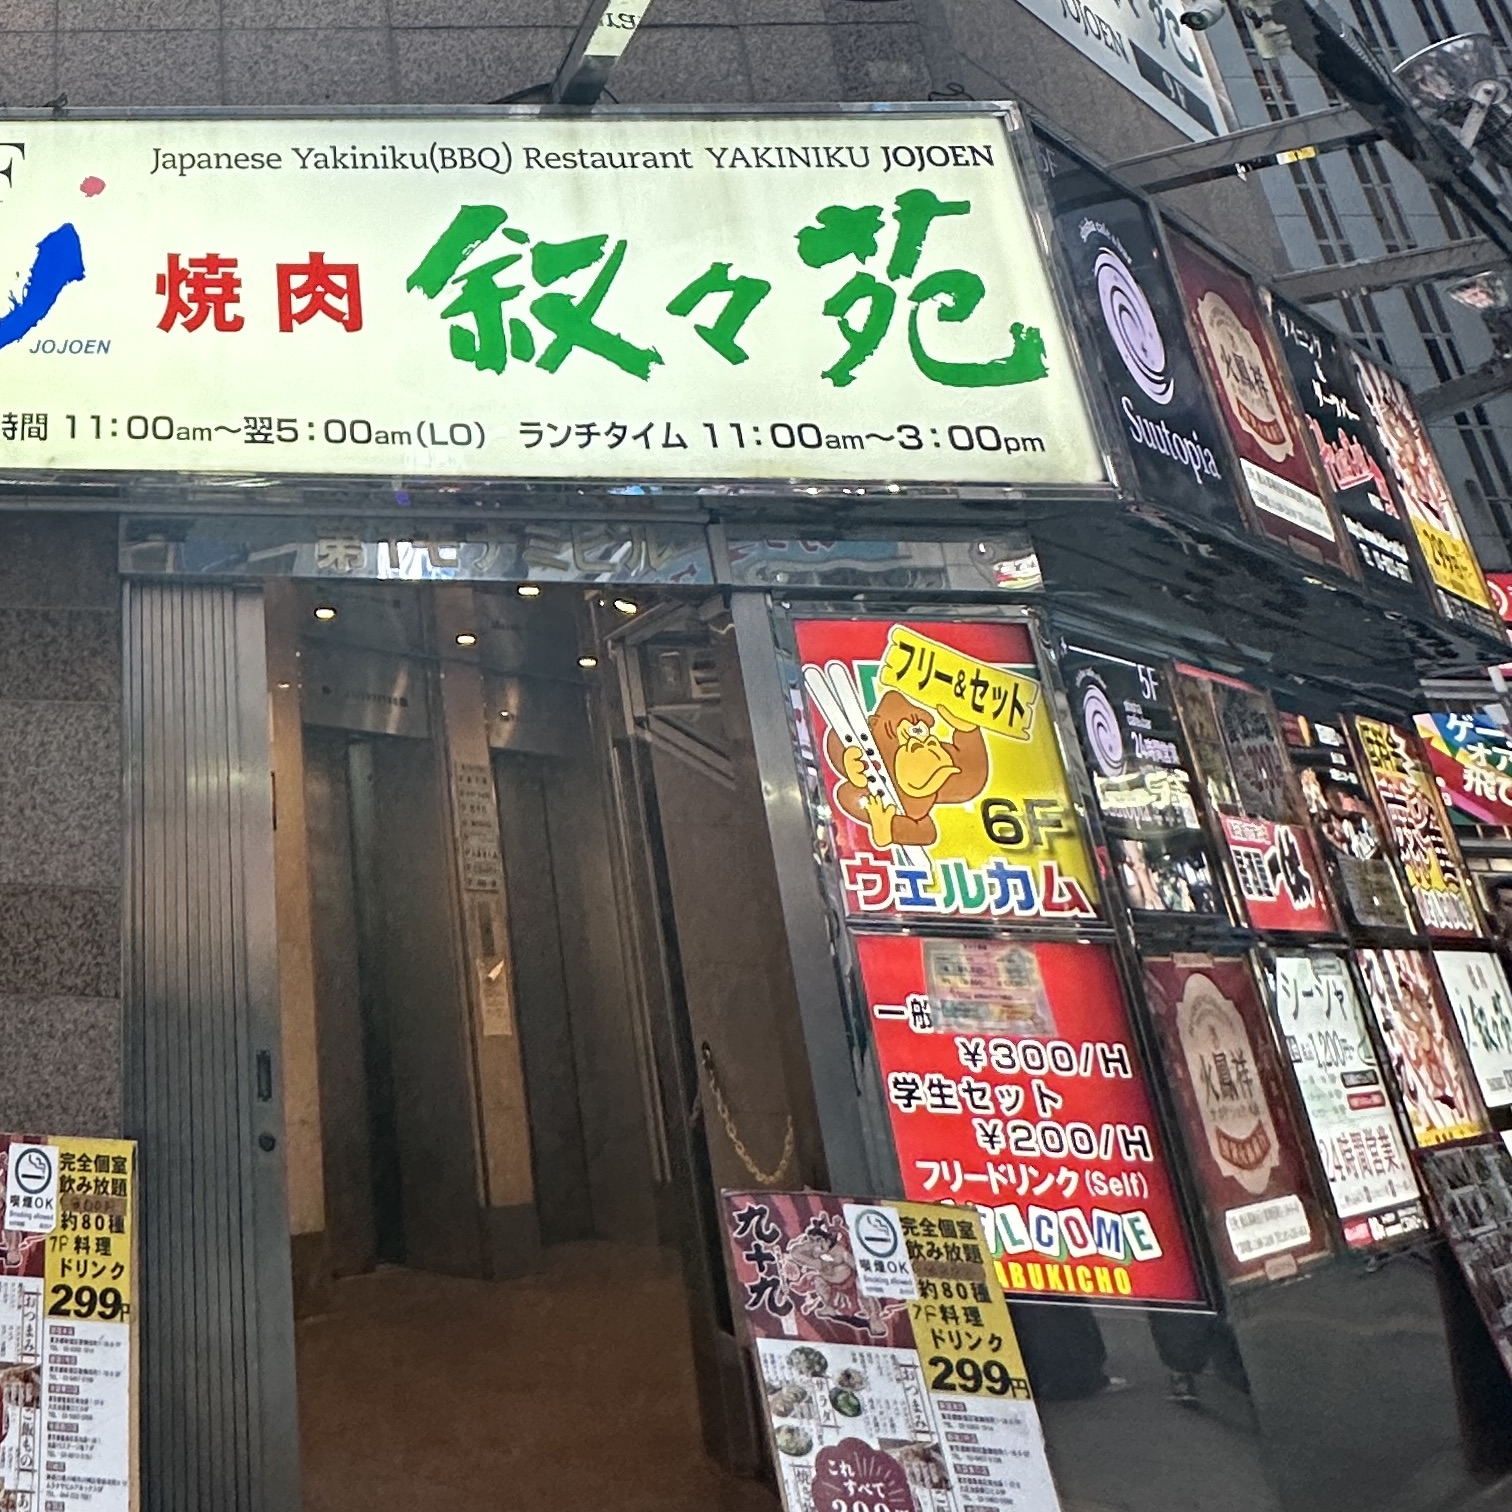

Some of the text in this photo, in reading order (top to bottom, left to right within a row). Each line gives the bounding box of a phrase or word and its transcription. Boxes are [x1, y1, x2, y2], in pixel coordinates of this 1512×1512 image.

[151, 142, 994, 179] Japanese Yakiniku(BBQ) Restaurant YAKINIKU JOJOEN
[155, 250, 363, 335] 焼肉
[406, 188, 1050, 388] 叙々苑
[28, 339, 112, 355] JOJOEN
[518, 420, 689, 453] ランチタイム
[1122, 396, 1221, 484] Suutopia
[896, 641, 1025, 728] フリー&セット
[981, 798, 1070, 846] 6F
[843, 856, 1094, 916] ウェルカム
[956, 1038, 1131, 1077] ¥300/H
[891, 1074, 1063, 1116] 学生セット
[974, 1120, 1153, 1161] ¥200/H
[60, 1153, 127, 1174] 完全個室
[917, 1160, 1149, 1199] フリードリンク (Self)
[10, 1195, 54, 1209] 喫煙OK
[60, 1175, 127, 1197] 飲み放題
[61, 1212, 125, 1233] 約80種
[900, 1217, 976, 1239] 完全個室
[983, 1206, 1159, 1260] LCOME
[74, 1235, 112, 1256] 料理
[733, 1204, 793, 1317] 九十九
[907, 1240, 983, 1263] 飲み放題
[61, 1258, 124, 1280] ドリンク
[940, 1305, 984, 1327] 料理
[931, 1329, 1003, 1352] ドリンク
[929, 1356, 1030, 1399] 299円
[828, 1460, 855, 1477] これ
[844, 1479, 886, 1498] すべて
